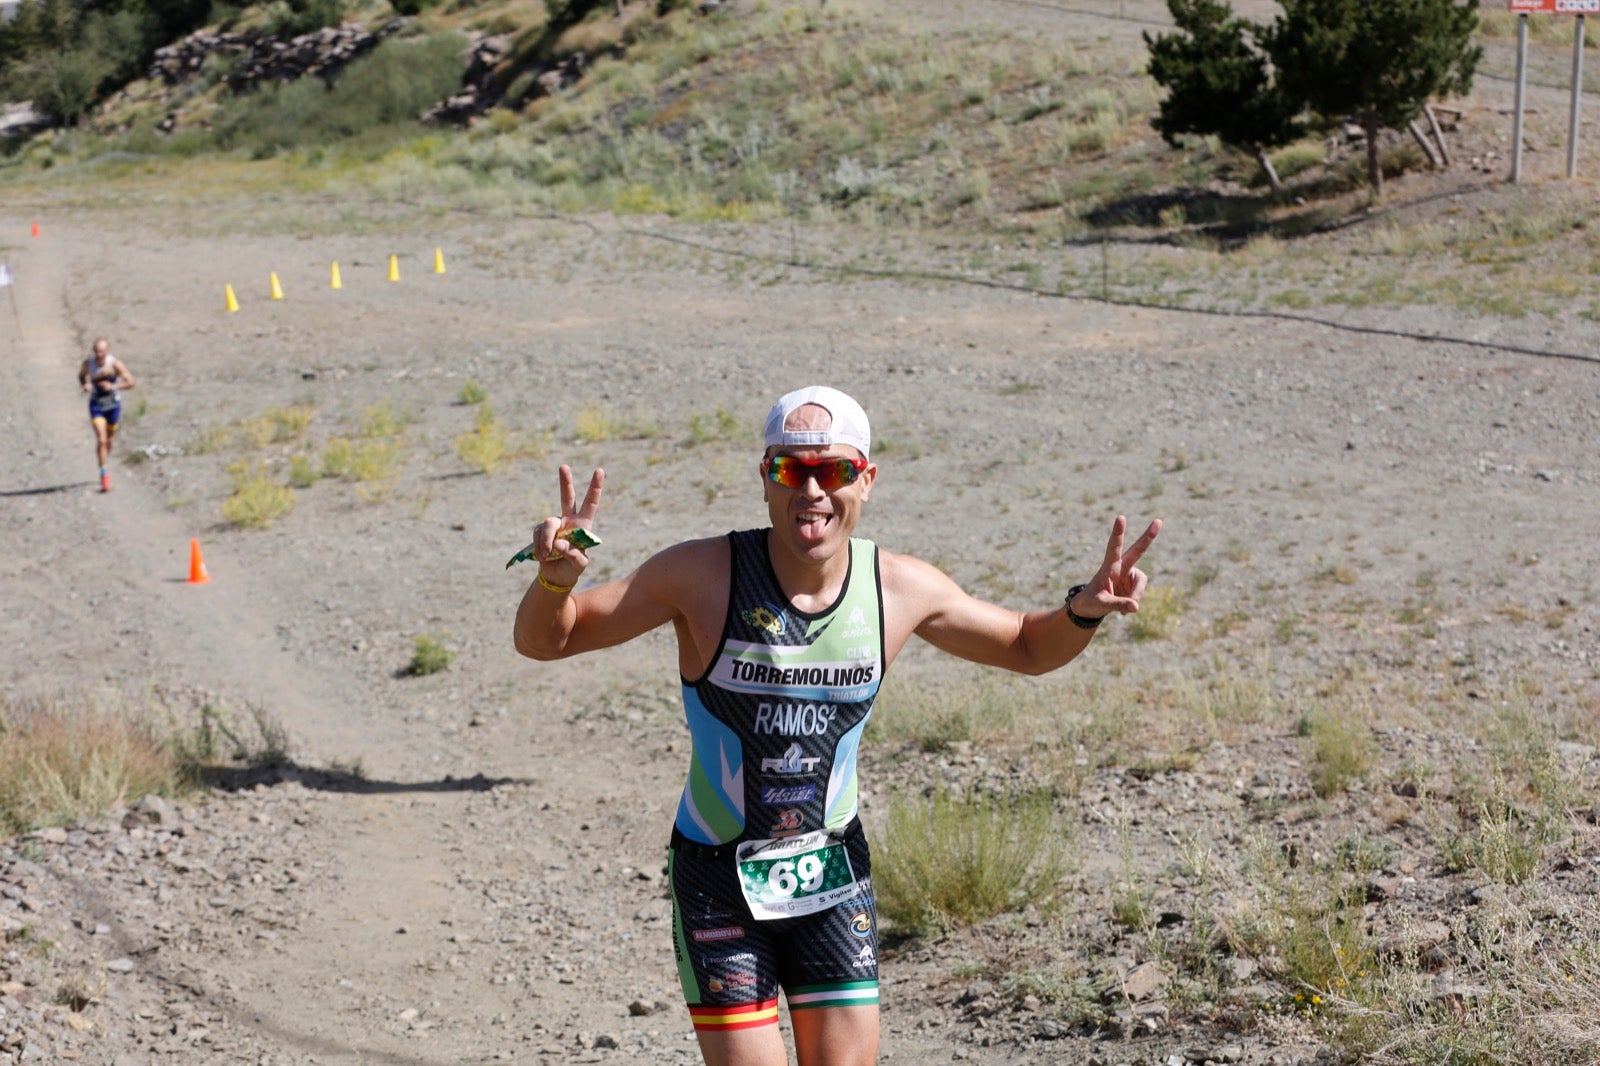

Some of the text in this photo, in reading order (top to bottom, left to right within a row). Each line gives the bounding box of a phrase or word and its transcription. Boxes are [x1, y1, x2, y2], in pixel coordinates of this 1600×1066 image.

[732, 659, 873, 687] TORREMOLINOS
[768, 855, 824, 896] 69
[695, 929, 743, 939] ALMODOVAR
